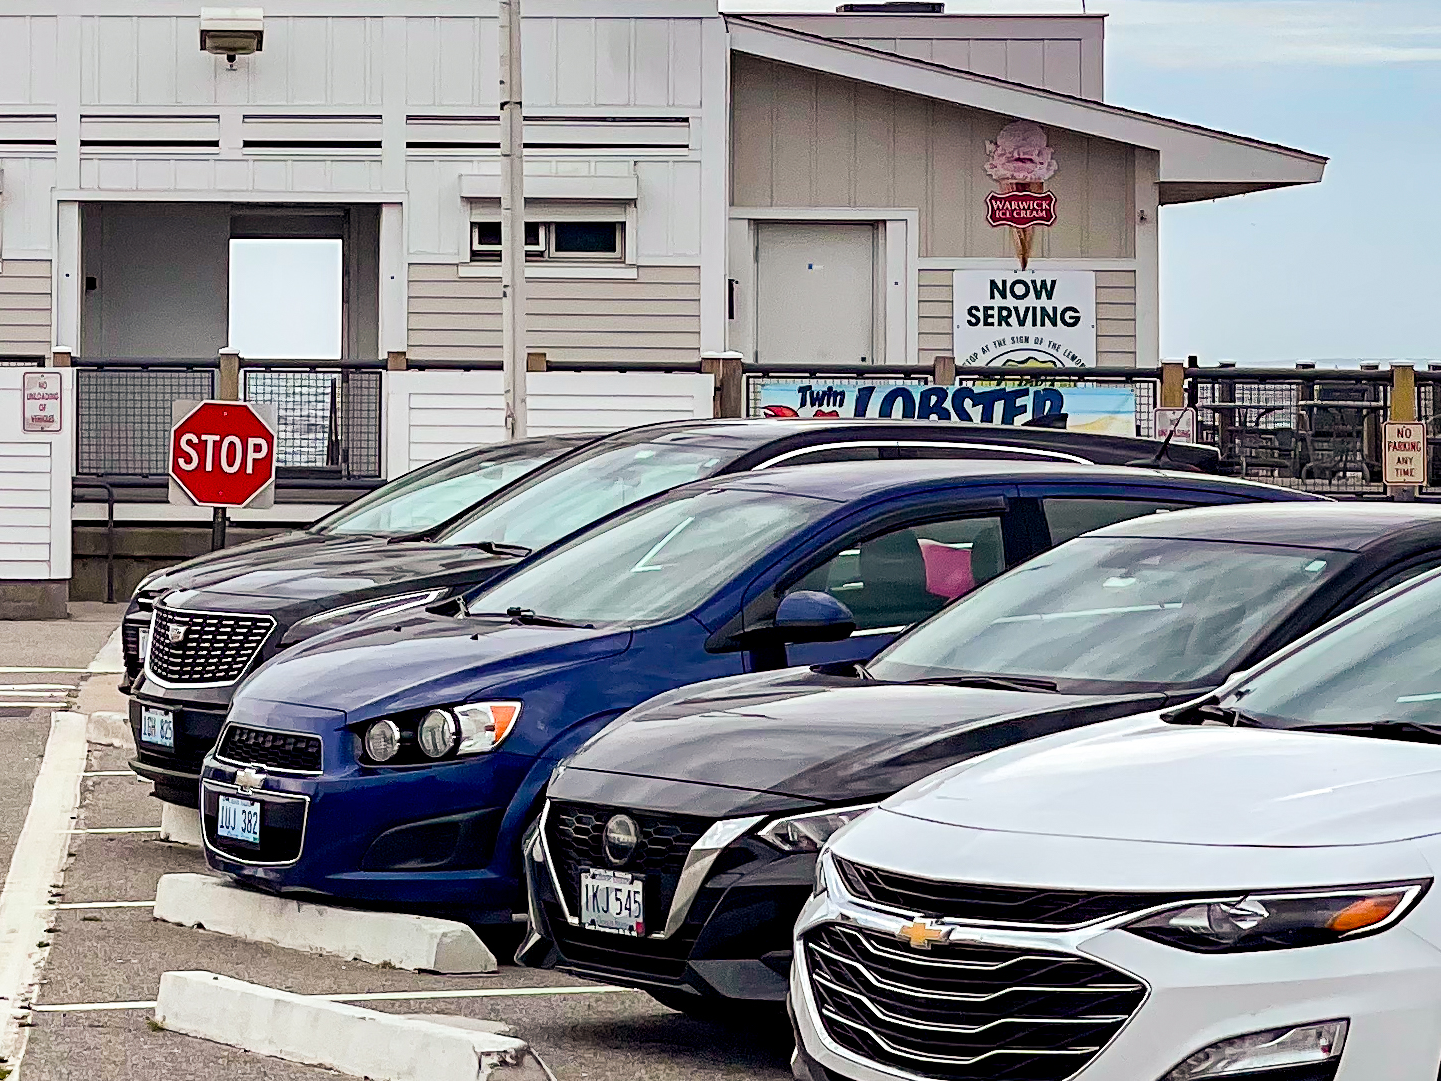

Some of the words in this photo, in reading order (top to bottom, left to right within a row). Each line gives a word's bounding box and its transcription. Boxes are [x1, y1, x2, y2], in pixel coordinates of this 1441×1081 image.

[991, 199, 1050, 210] WARWICK
[995, 209, 1012, 218] ICE
[1013, 209, 1047, 218] CREAM
[989, 278, 1057, 300] NOW
[966, 305, 1081, 328] SERVING
[981, 344, 991, 355] AT
[993, 337, 1007, 349] THE
[1011, 336, 1030, 345] SIGN
[1034, 336, 1044, 346] OF
[1048, 340, 1062, 352] THE
[38, 381, 48, 390] NO
[797, 384, 846, 409] Twin
[38, 403, 47, 412] OF
[1396, 427, 1412, 439] NO
[1387, 440, 1422, 453] PARKING
[177, 432, 269, 475] STOP
[1396, 456, 1414, 466] ANY
[1394, 467, 1415, 477] TIME
[241, 809, 258, 835] 382
[614, 887, 641, 919] 545
